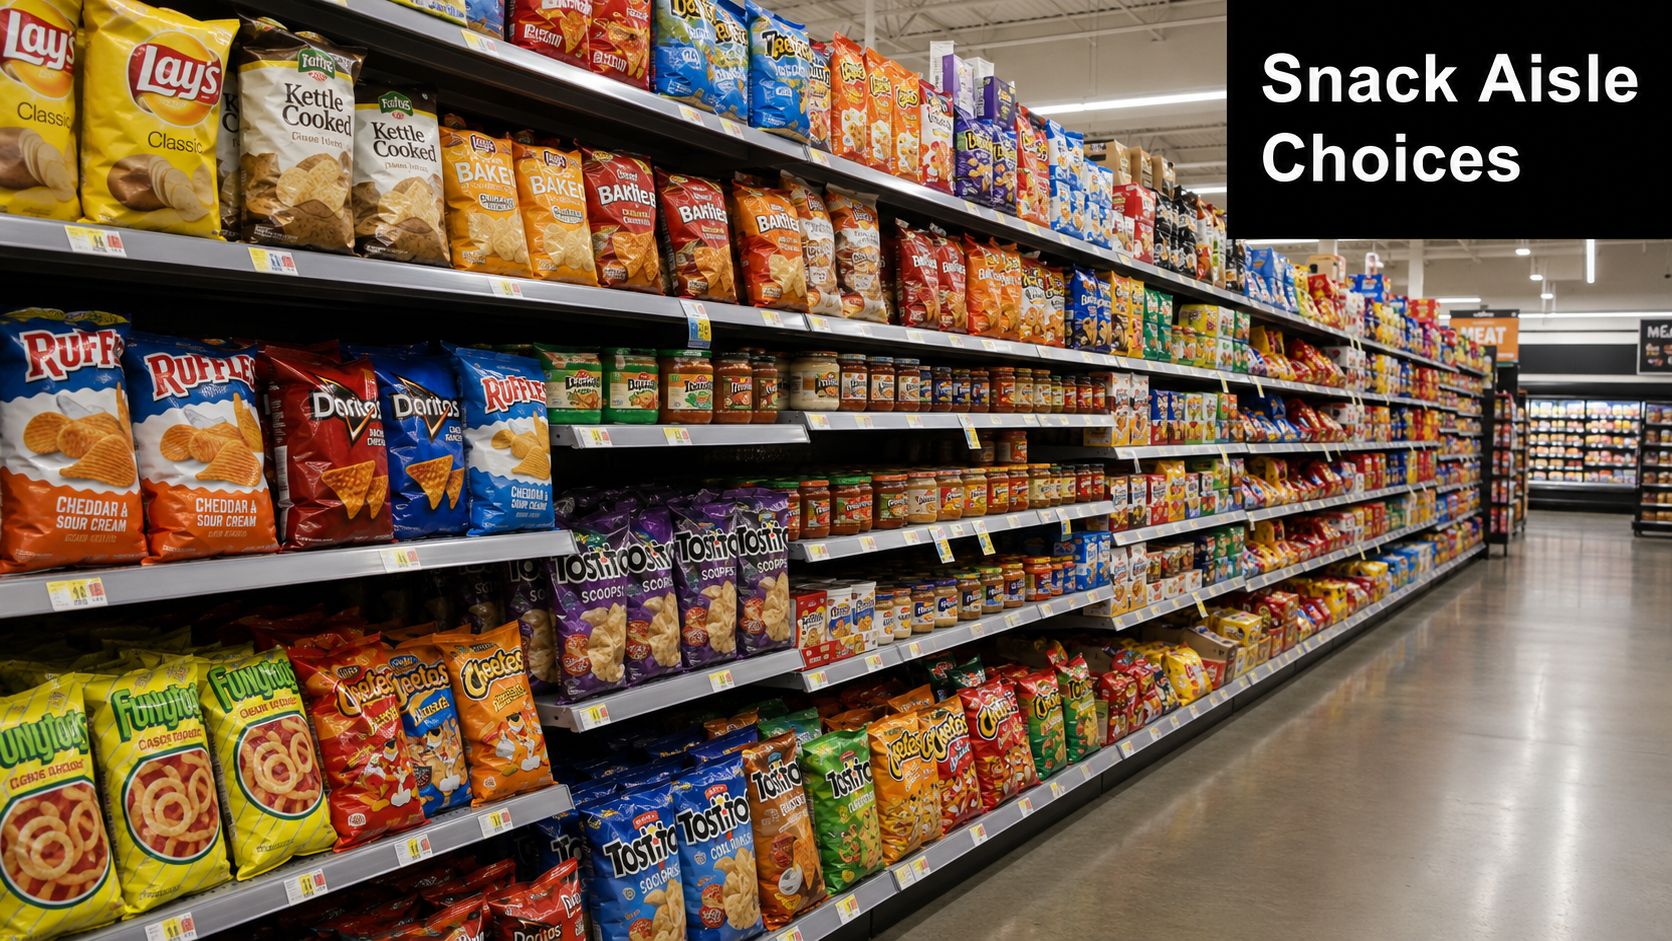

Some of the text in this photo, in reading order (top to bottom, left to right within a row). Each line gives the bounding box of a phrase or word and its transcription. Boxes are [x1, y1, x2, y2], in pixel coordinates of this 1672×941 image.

[137, 45, 220, 100] Lay's
[285, 83, 343, 113] Kettle
[17, 102, 72, 129] Classic
[282, 105, 352, 137] Cooked
[147, 131, 204, 154] Classic
[371, 122, 424, 143] Kettle
[373, 141, 437, 163] Cooked
[1460, 326, 1507, 345] MEAT
[392, 393, 460, 418] Doritos
[56, 496, 118, 517] CHEDDAR
[195, 497, 248, 514] CHEDDAR
[56, 515, 127, 532] SOUR CREAM
[197, 514, 257, 527] SOUR CREAM
